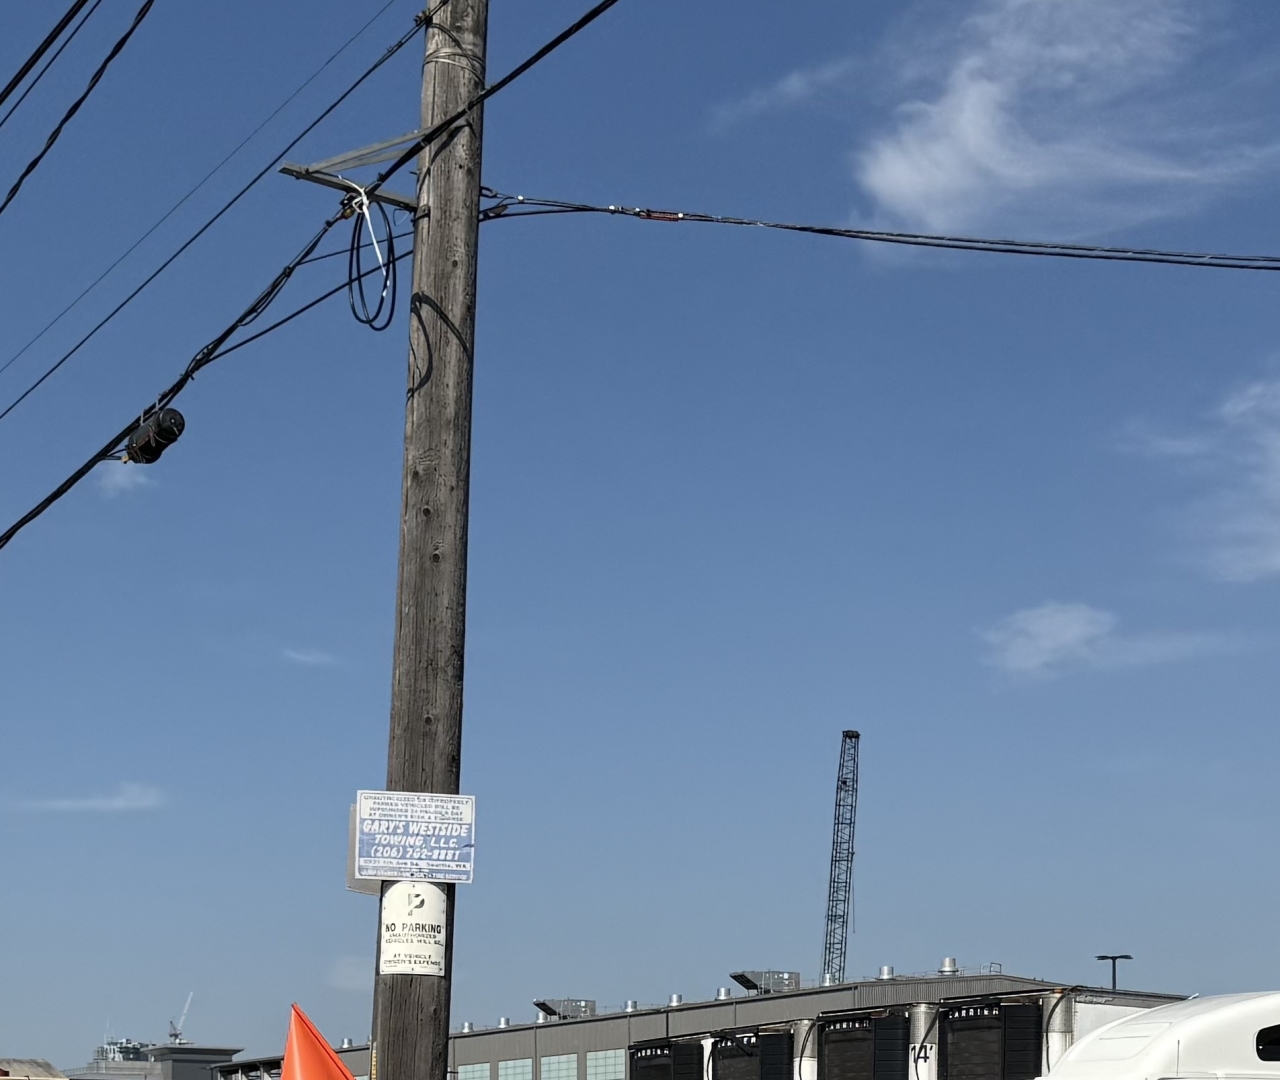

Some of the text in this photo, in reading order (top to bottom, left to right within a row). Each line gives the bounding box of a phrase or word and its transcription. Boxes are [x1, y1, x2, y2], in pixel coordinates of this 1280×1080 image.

[363, 820, 470, 836] GARY'S WESTSIDE
[371, 846, 403, 858] (206)
[386, 923, 441, 934] NO PARKING
[949, 1008, 999, 1018] CARRIER
